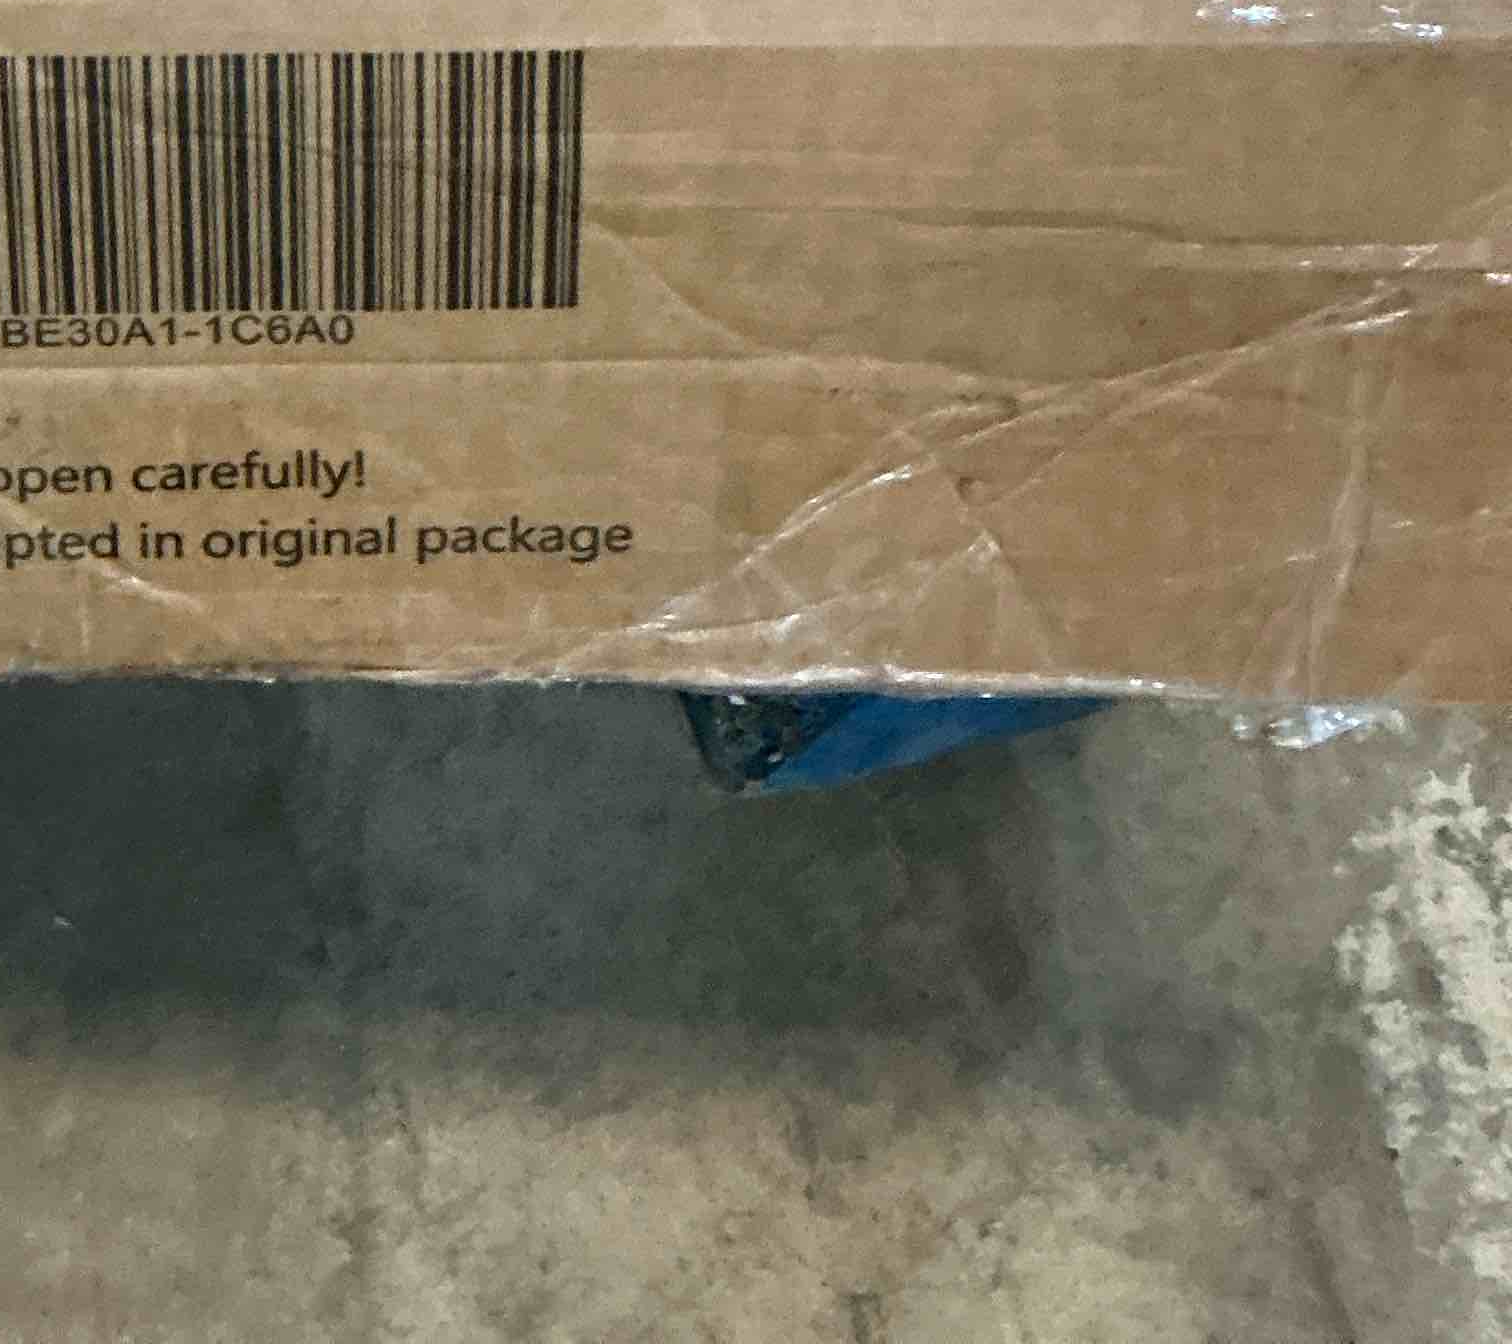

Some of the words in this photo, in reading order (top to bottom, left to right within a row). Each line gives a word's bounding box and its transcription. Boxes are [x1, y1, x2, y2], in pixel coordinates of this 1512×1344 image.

[131, 449, 366, 498] carefully!
[138, 521, 184, 560] in
[201, 516, 397, 568] original
[416, 515, 634, 565] package
